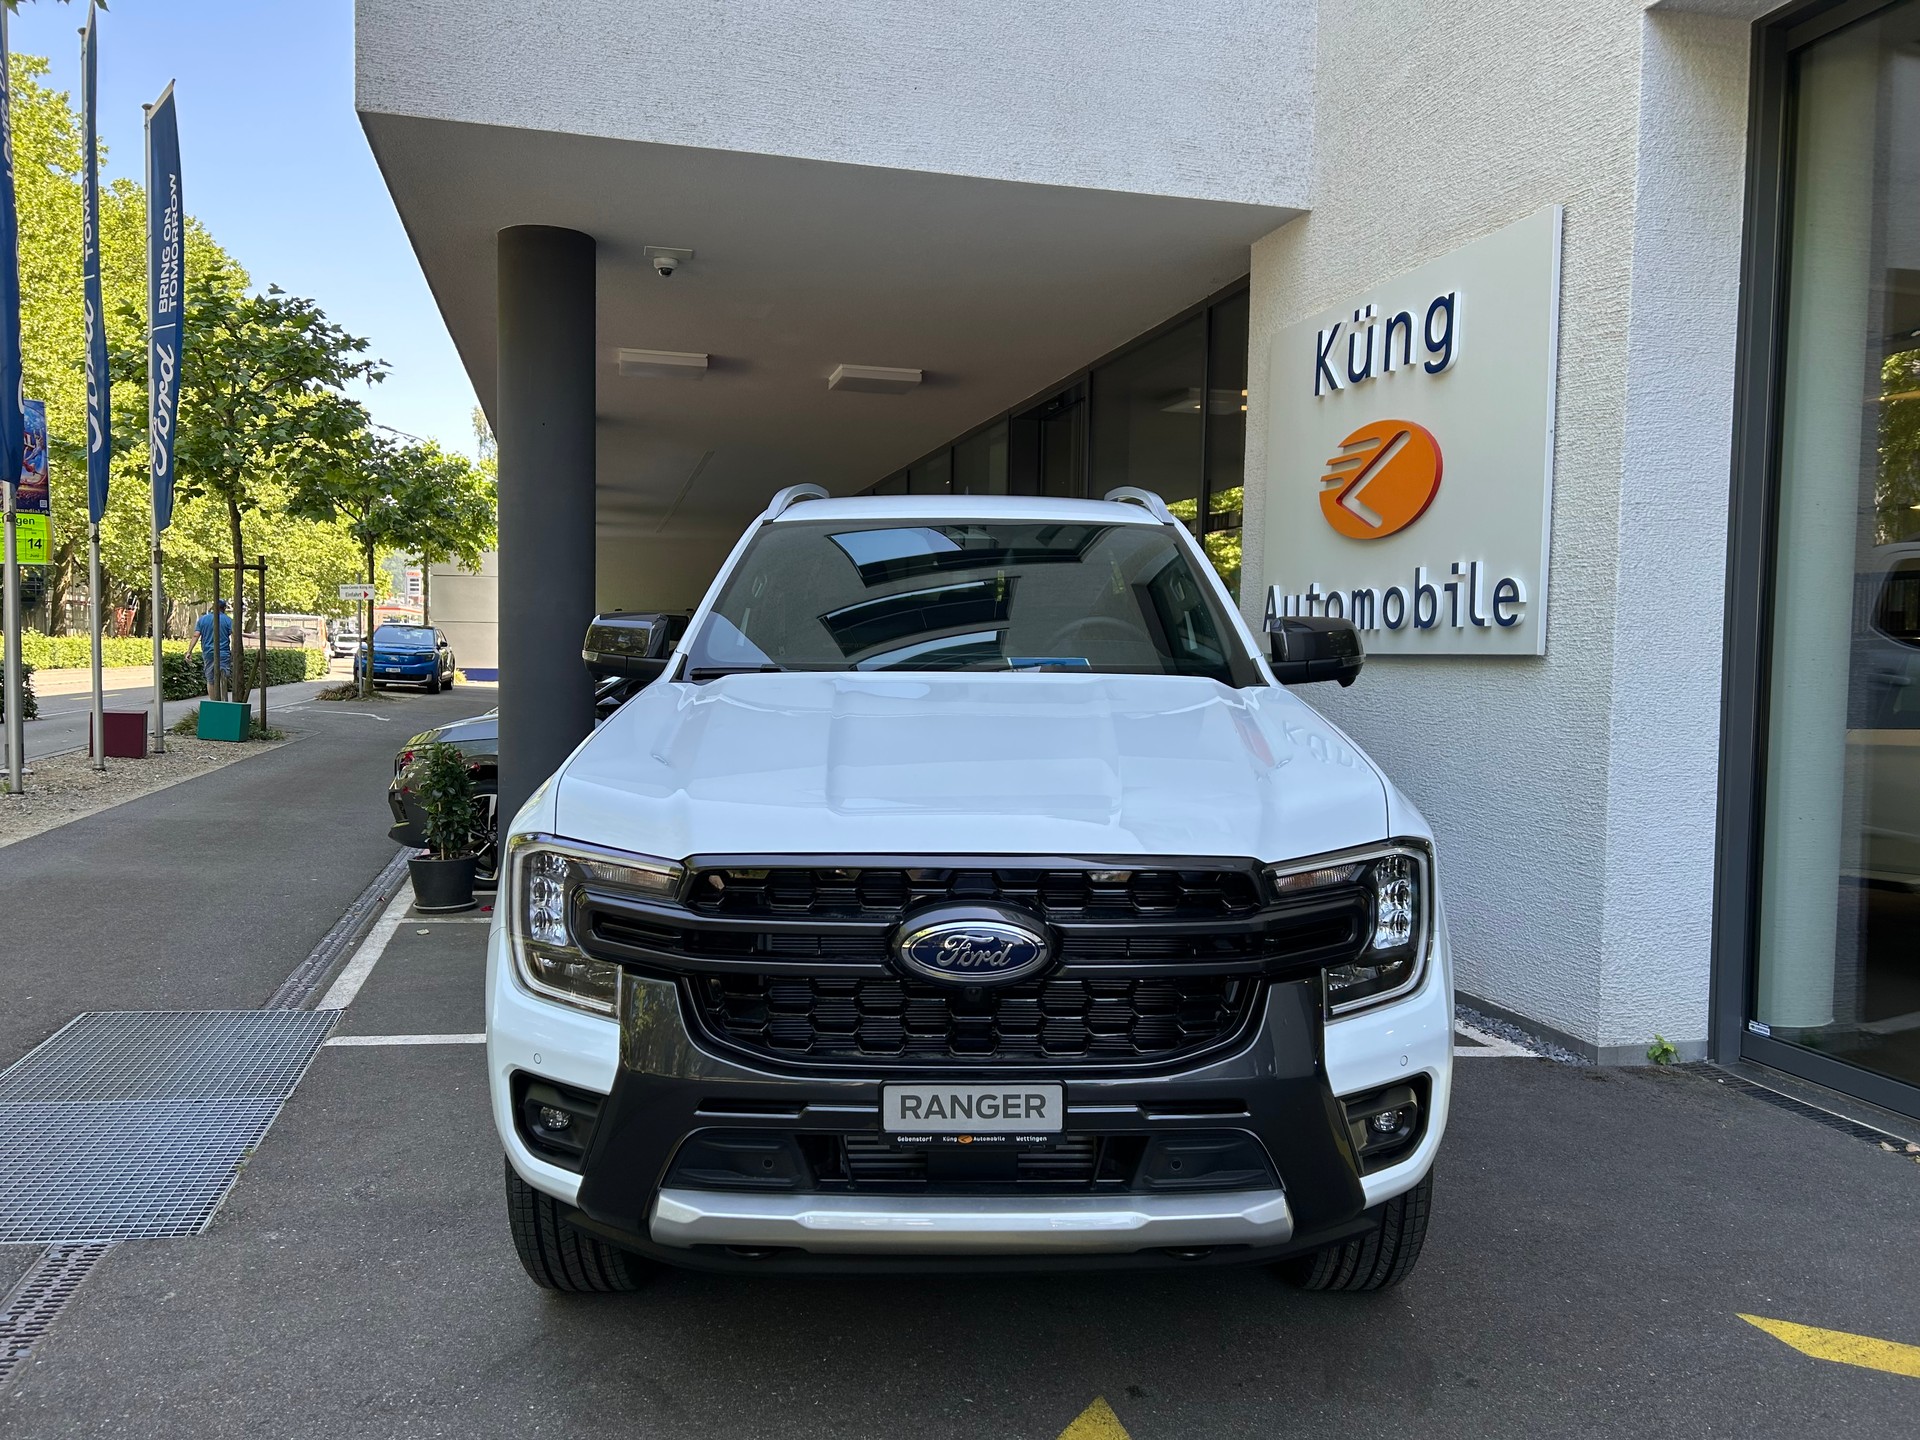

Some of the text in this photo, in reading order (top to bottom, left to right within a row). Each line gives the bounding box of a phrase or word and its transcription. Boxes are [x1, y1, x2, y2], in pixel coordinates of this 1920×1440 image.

[158, 206, 172, 314] BRING ON
[168, 173, 179, 313] TOMORROW
[1314, 290, 1459, 396] Küng
[150, 343, 175, 477] Ford
[28, 538, 42, 549] 14
[1263, 561, 1524, 633] Automobile
[936, 934, 1013, 967] Ford
[897, 1135, 1047, 1143] Gebenstorf Küng Automobile Wettingen
[901, 1094, 1046, 1119] RANGER
